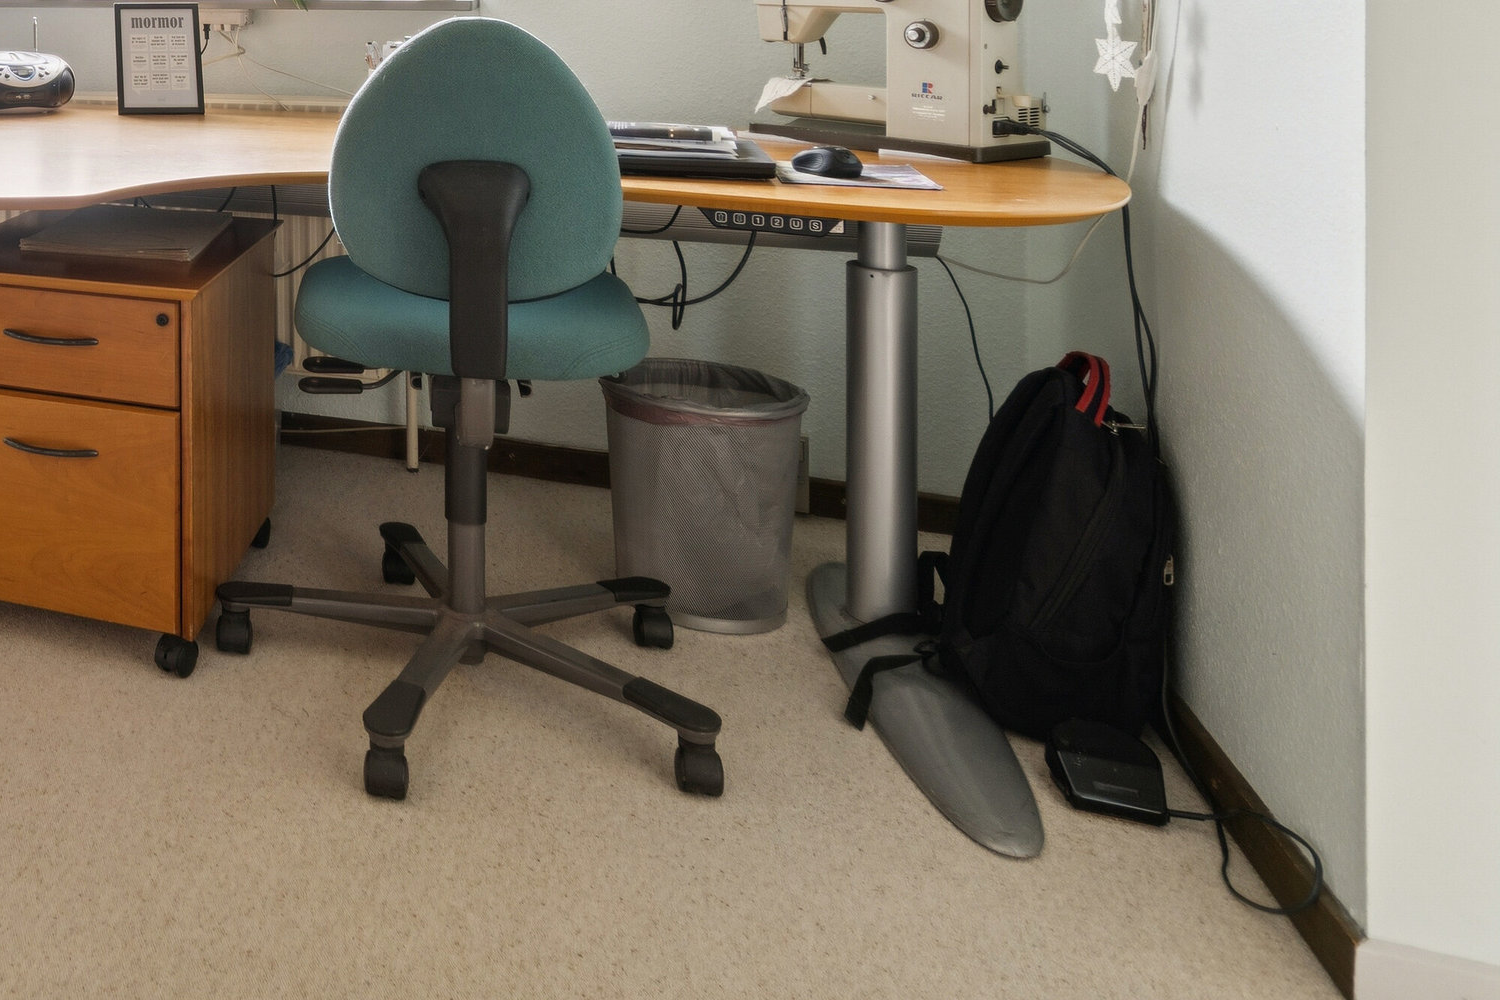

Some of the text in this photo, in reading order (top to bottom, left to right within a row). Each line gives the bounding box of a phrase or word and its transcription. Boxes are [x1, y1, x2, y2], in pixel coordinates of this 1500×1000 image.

[131, 17, 184, 29] mormor
[793, 220, 800, 228] U
[812, 222, 819, 230] S
